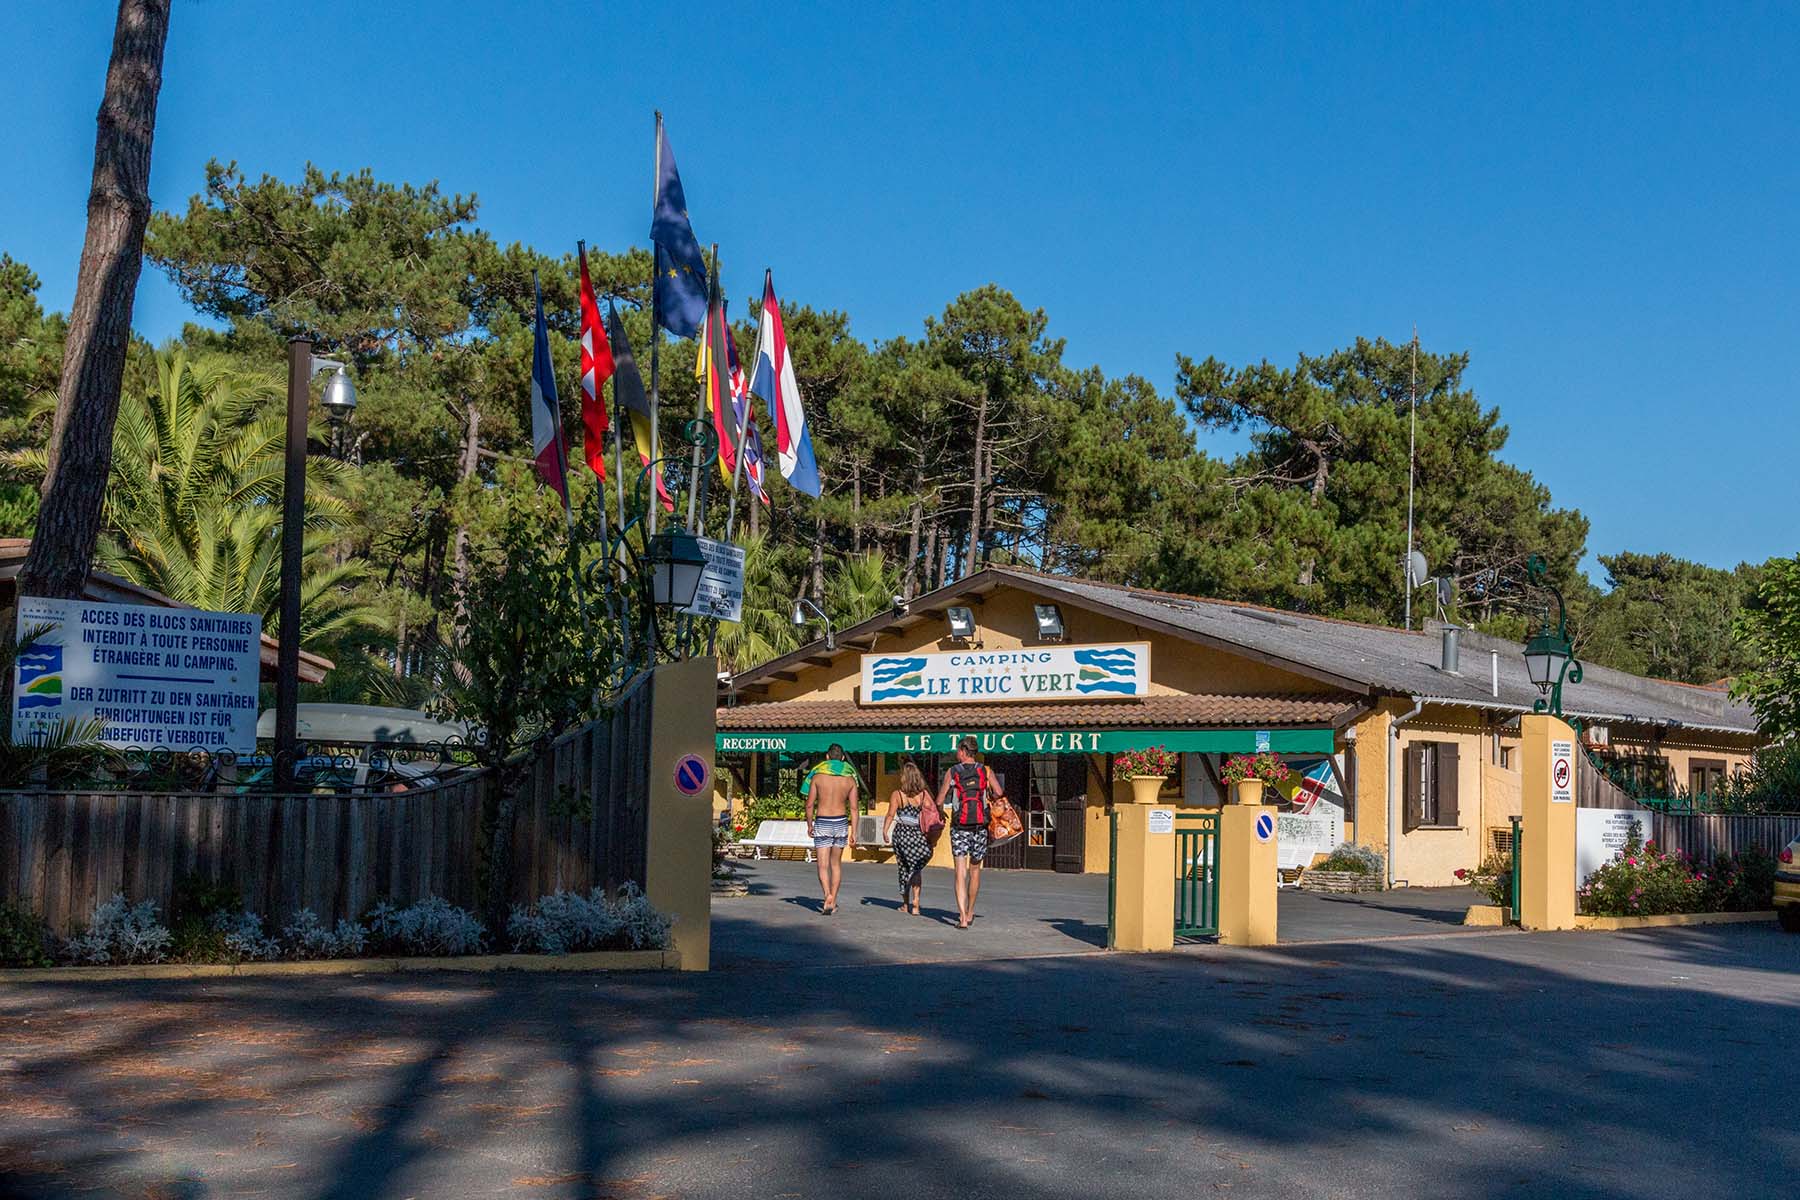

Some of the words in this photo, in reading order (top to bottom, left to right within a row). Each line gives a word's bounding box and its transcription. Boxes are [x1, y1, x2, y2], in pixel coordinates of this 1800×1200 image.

[81, 609, 119, 626] ACCES
[124, 612, 145, 628] DES
[150, 614, 186, 630] BLOCS
[190, 617, 253, 635] SANITAIRES
[83, 629, 137, 646] INTERDIT
[140, 629, 148, 648] À
[152, 633, 188, 650] TOUTE
[192, 636, 249, 654] PERSONNE
[93, 645, 161, 667] ÉTRANGÈRE
[165, 653, 180, 668] AU
[184, 654, 238, 672] CAMPING.
[950, 652, 1052, 666] CAMPING
[927, 678, 951, 695] LE
[958, 675, 1012, 694] TRUC
[1020, 672, 1076, 692] VERT
[70, 686, 94, 702] DER
[98, 688, 147, 704] ZUTRITT
[150, 691, 166, 705] ZU
[170, 692, 192, 706] DEN
[196, 691, 255, 710] SANITÄREN
[94, 707, 185, 725] EINRICHTUNGEN
[190, 711, 208, 726] IST
[211, 710, 232, 727] FÜR
[98, 727, 163, 743] UNBEFUGTE
[168, 729, 228, 745] VERBOTEN.
[722, 737, 787, 750] RECEPTION
[904, 735, 932, 751] LE
[949, 734, 1015, 751] TUC
[1034, 733, 1102, 750] VERT
